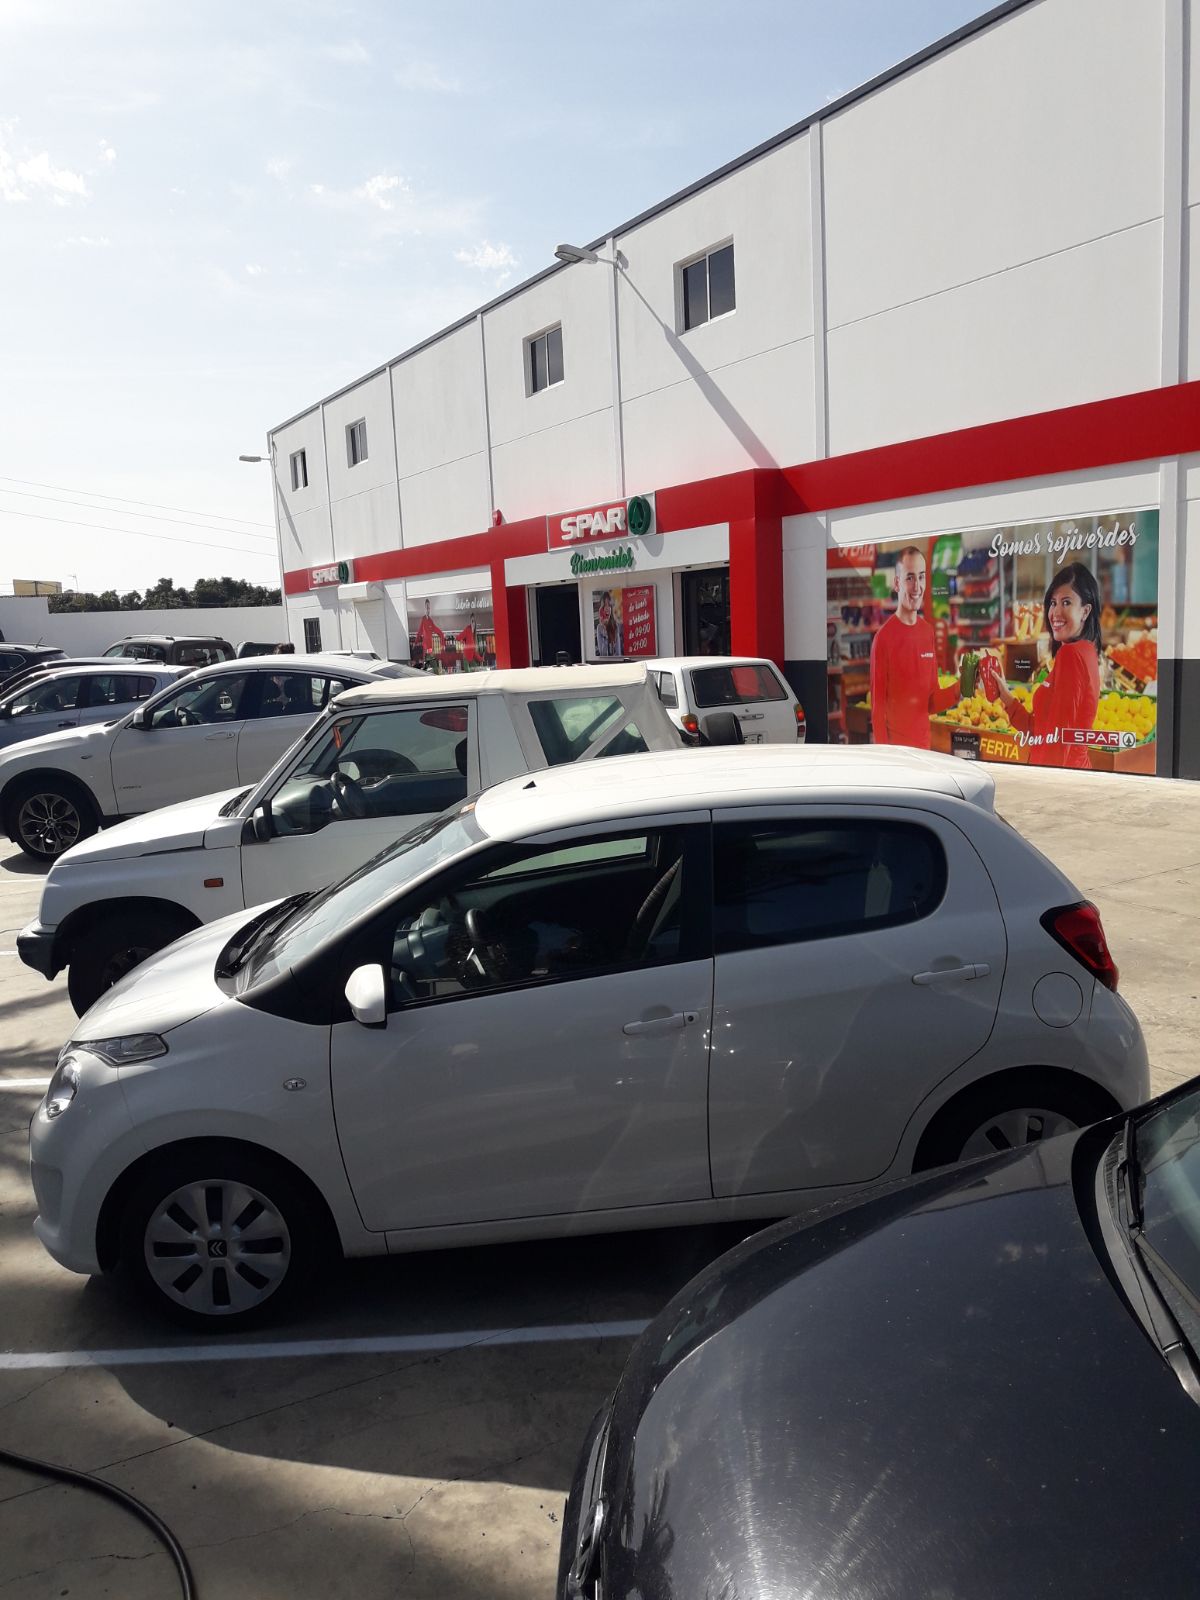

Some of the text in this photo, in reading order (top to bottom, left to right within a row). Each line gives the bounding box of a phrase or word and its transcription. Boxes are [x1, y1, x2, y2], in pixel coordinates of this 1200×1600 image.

[560, 507, 626, 541] SPAR
[988, 521, 1140, 565] Somos rojiverdes
[312, 566, 339, 585] SPAR
[570, 546, 634, 576] Bienvenidos
[1014, 727, 1119, 748] Ven al SPAR
